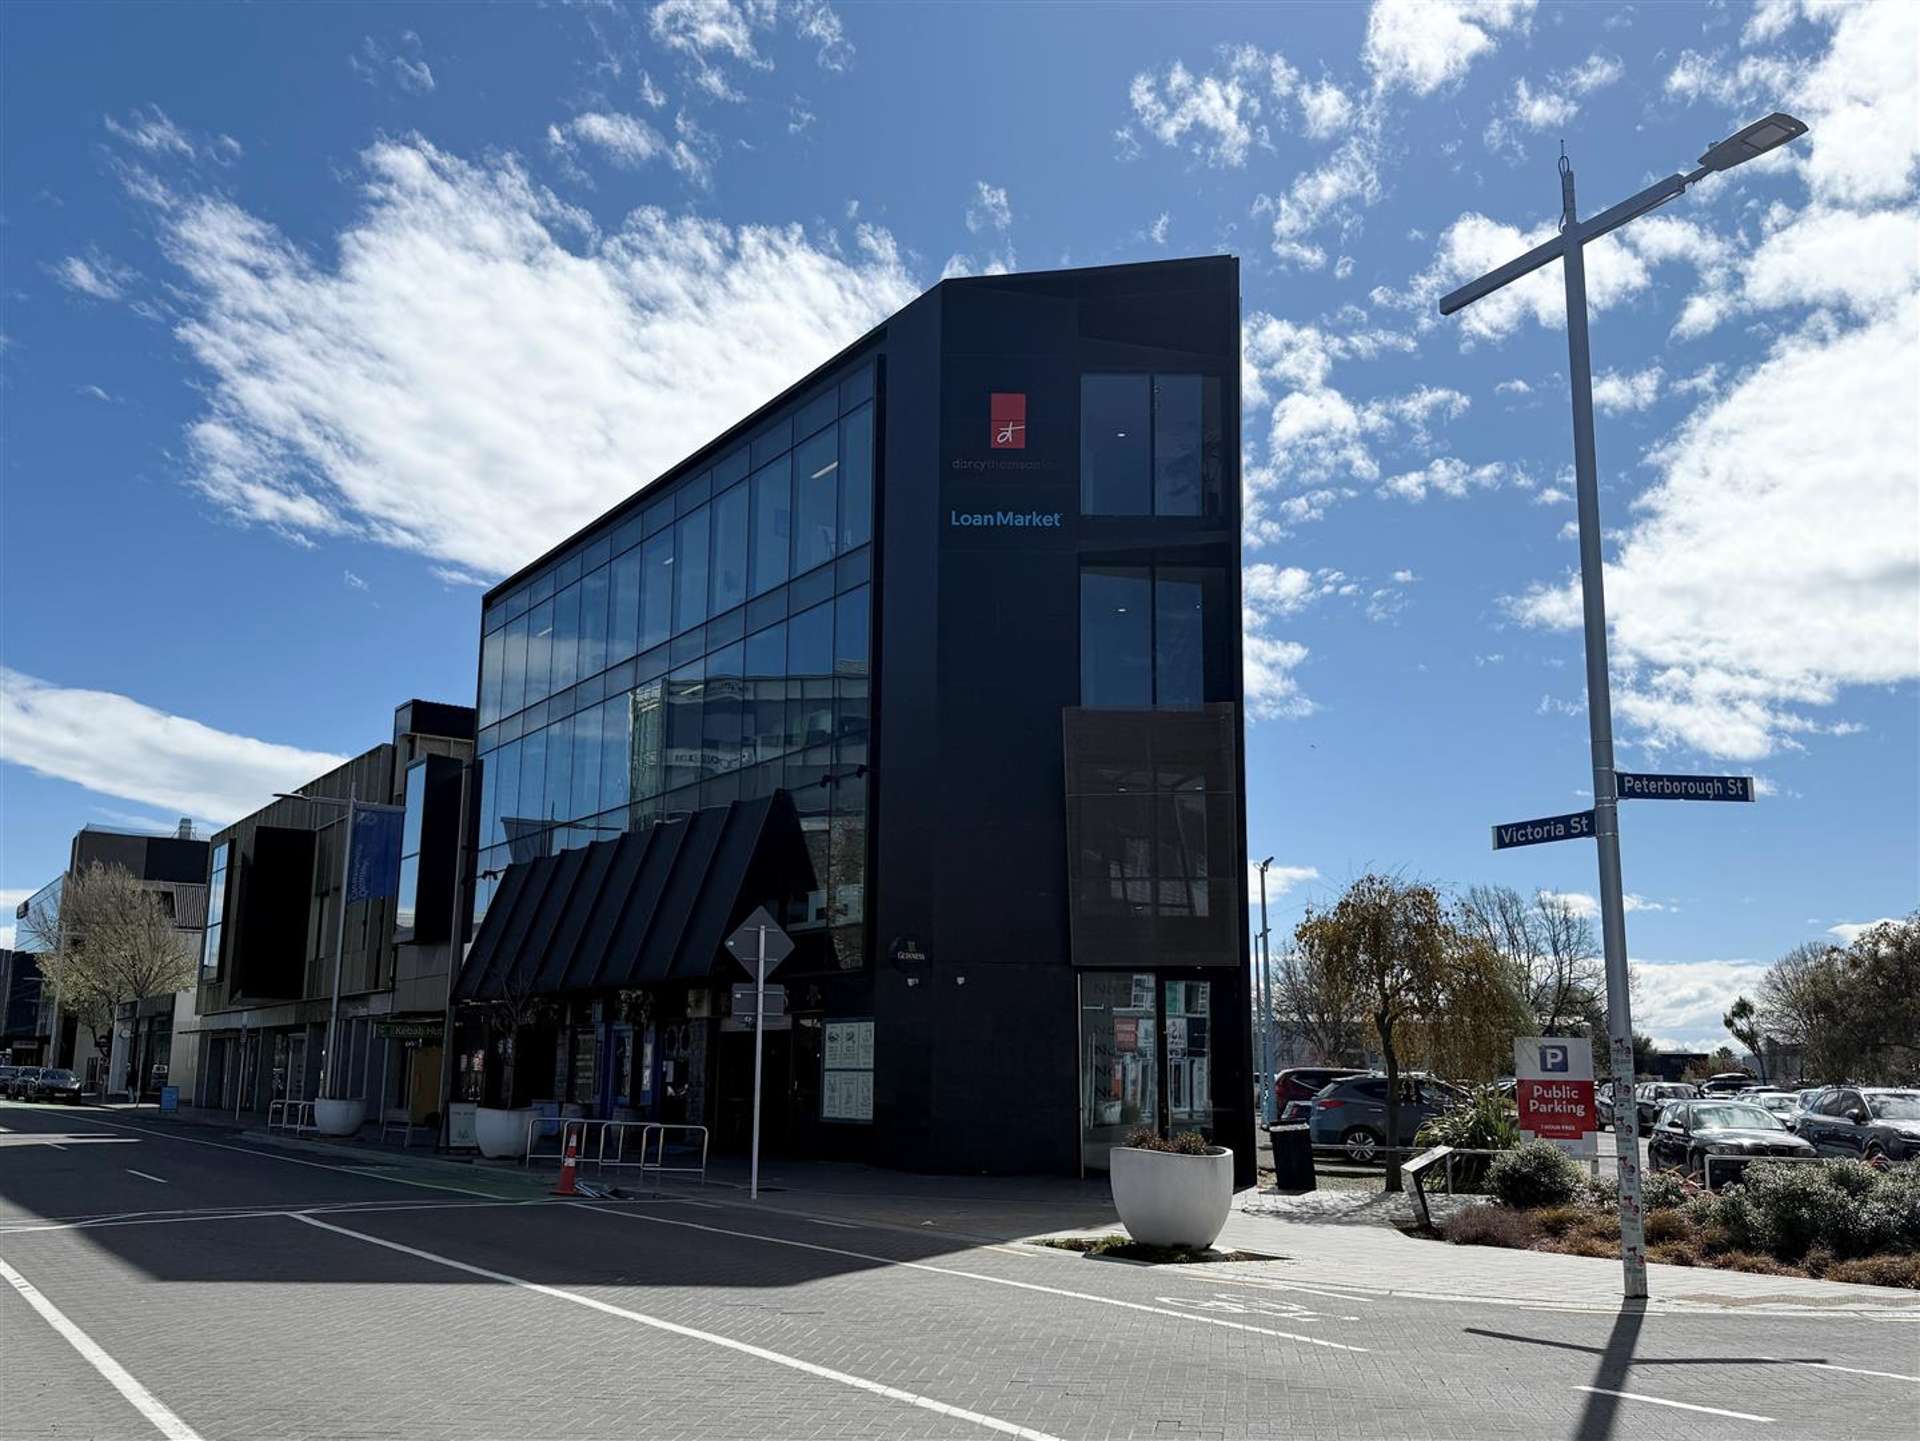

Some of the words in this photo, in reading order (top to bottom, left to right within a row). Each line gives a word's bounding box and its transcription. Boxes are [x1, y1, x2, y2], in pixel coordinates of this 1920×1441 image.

[1623, 776, 1723, 799] Peterborough
[1728, 781, 1743, 796] St
[1501, 823, 1565, 844] Victoria
[1570, 816, 1589, 834] St
[1547, 1049, 1563, 1069] P
[1533, 1085, 1579, 1099] Public
[1529, 1100, 1585, 1116] Parking
